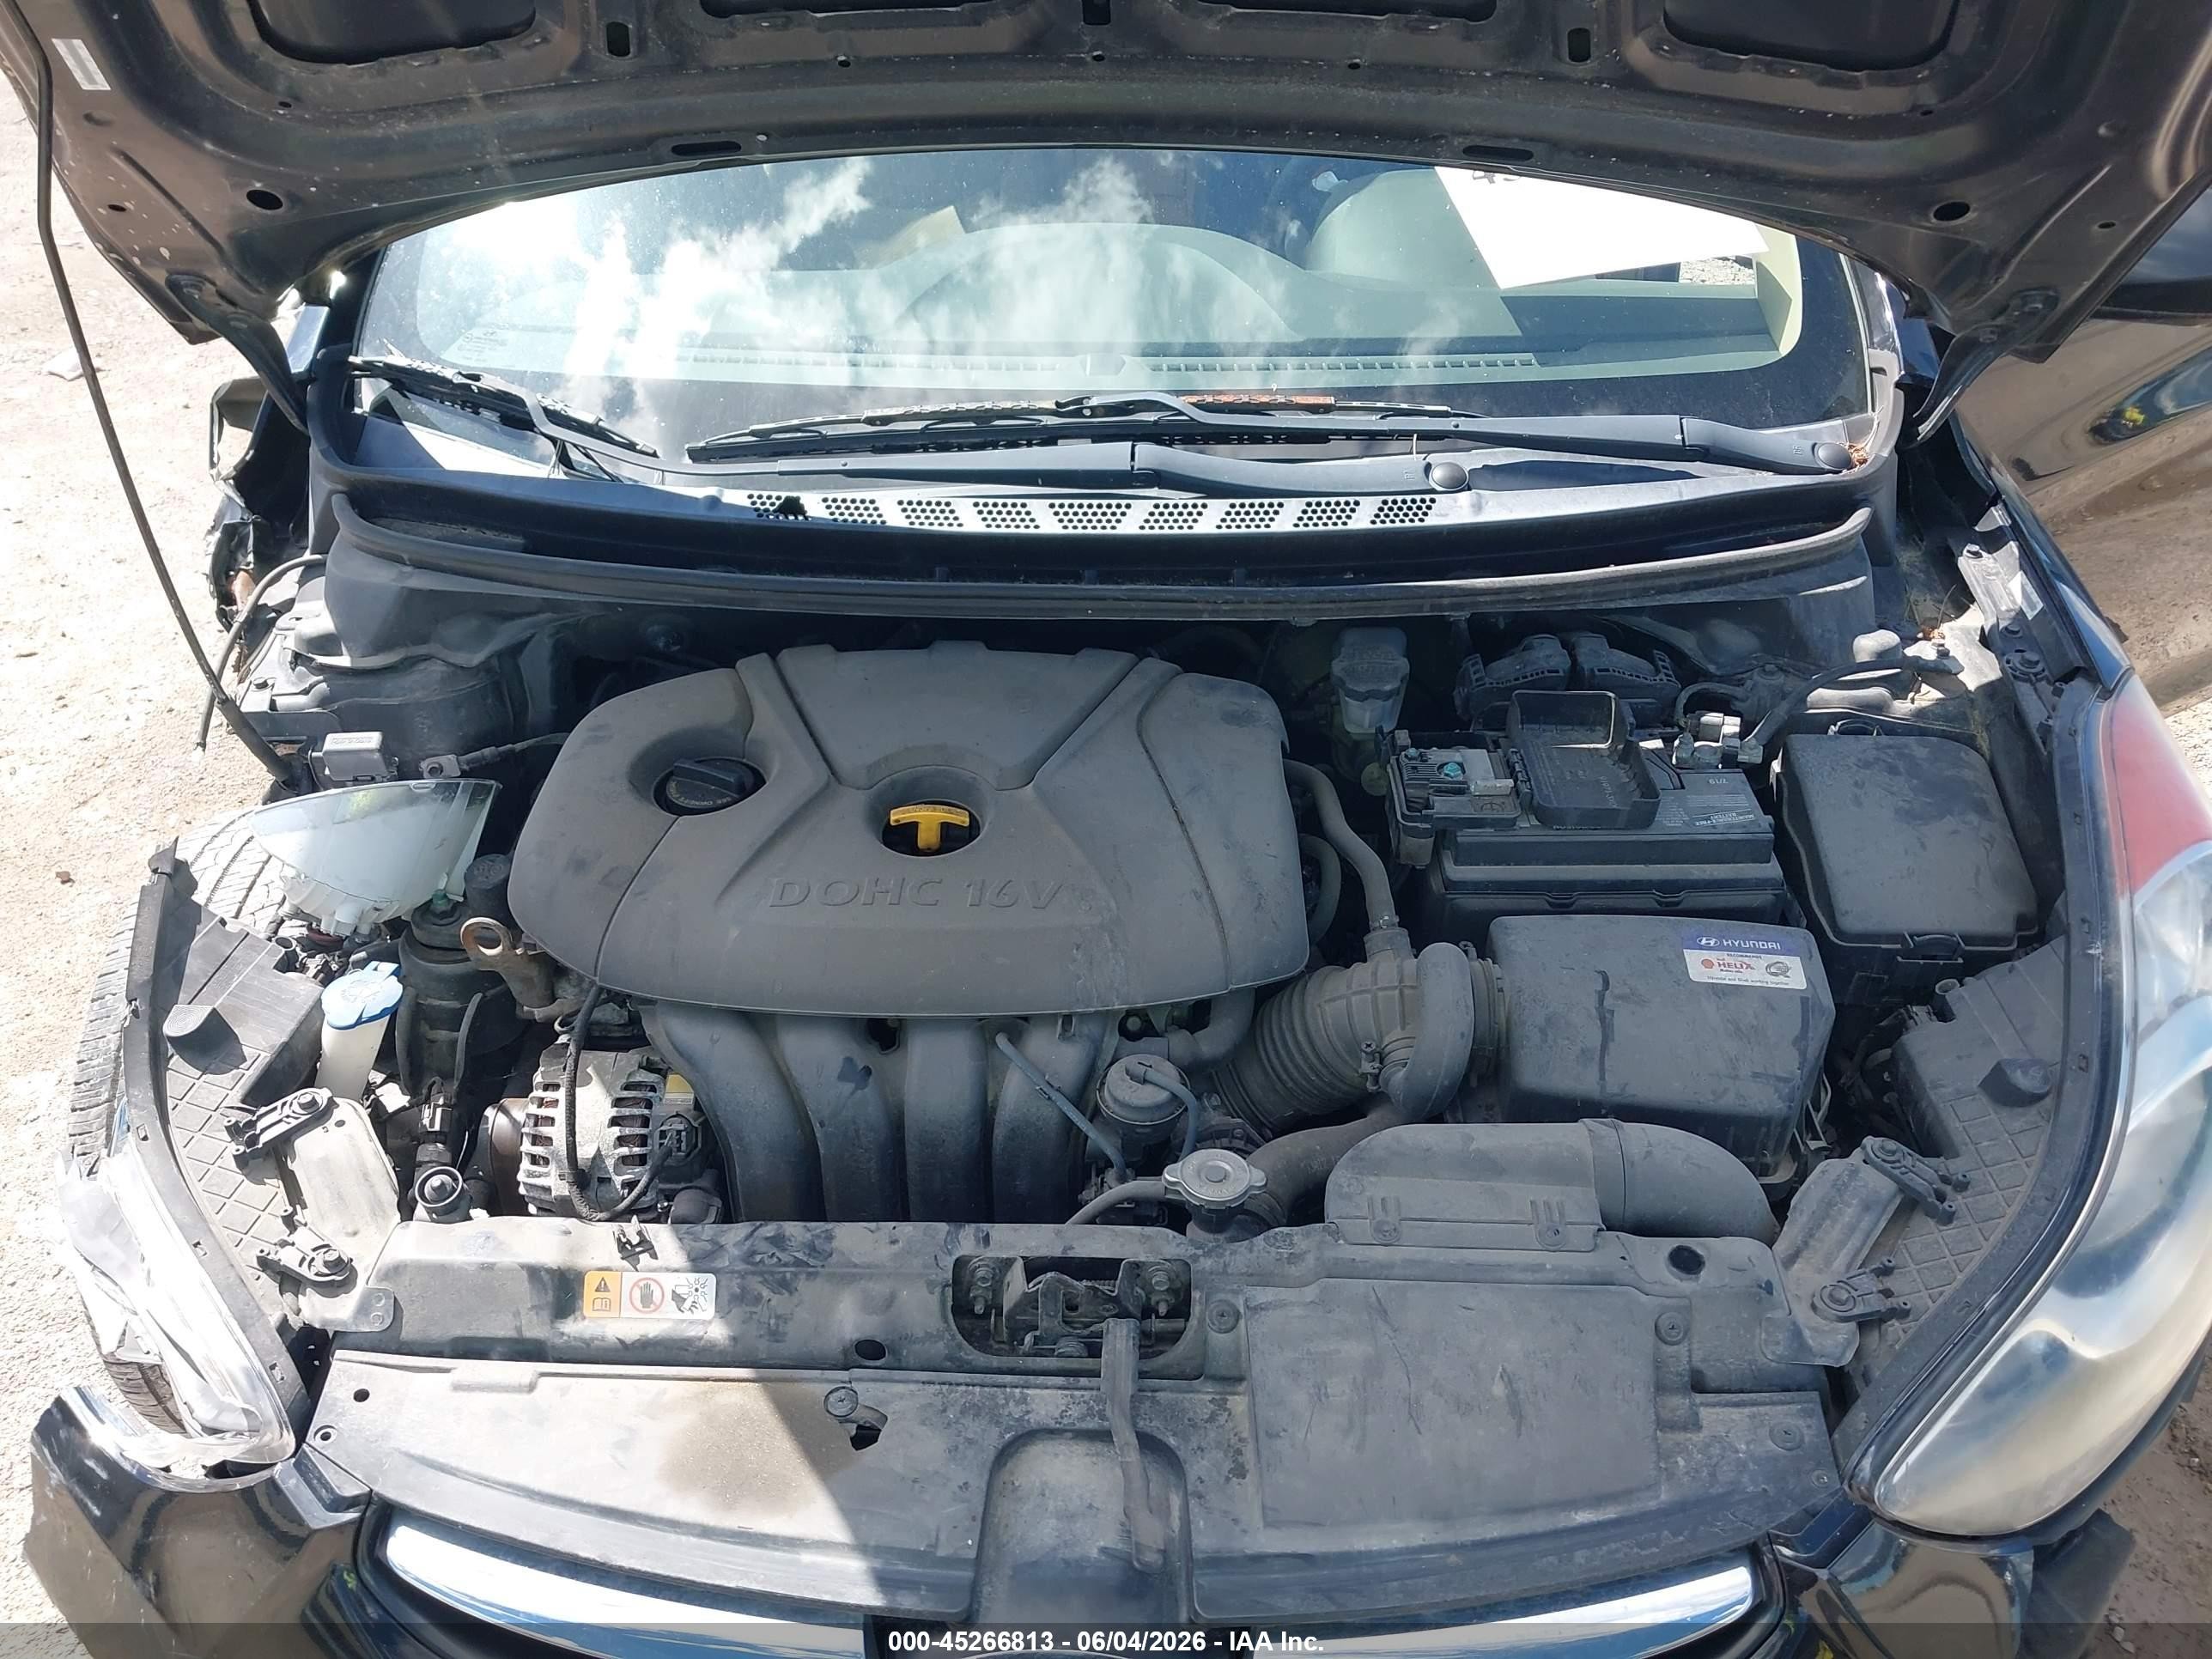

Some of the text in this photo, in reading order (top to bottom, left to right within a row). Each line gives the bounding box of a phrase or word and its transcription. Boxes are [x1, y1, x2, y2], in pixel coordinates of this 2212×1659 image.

[769, 877, 1064, 909] DOHC 16V
[1723, 939, 1781, 950] HYUNDAI
[1717, 961, 1756, 969] HELIX
